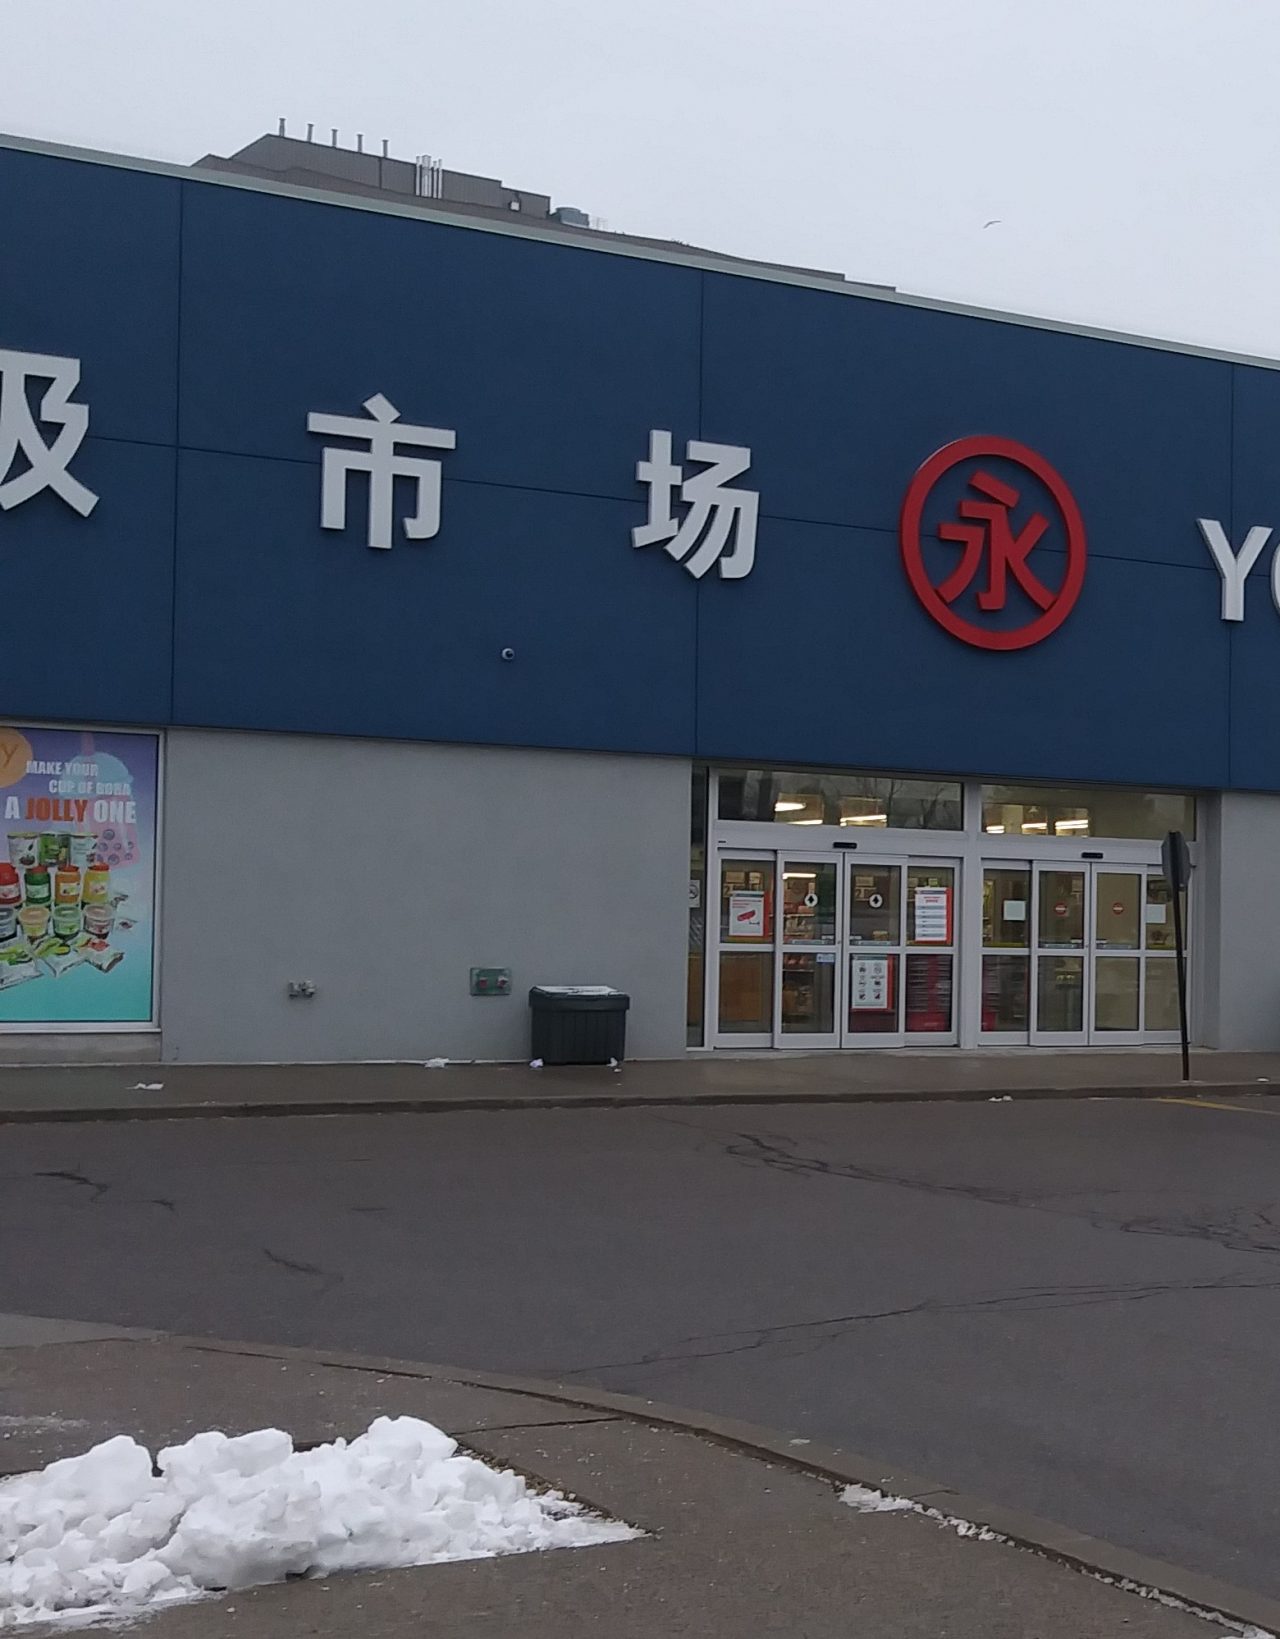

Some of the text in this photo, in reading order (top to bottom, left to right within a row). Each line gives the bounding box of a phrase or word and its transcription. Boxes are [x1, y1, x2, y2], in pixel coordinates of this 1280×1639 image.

[26, 760, 98, 776] MAKE YOUR
[48, 779, 75, 793] CUP
[78, 781, 93, 794] OF
[4, 796, 137, 824] A JOLLY ONE
